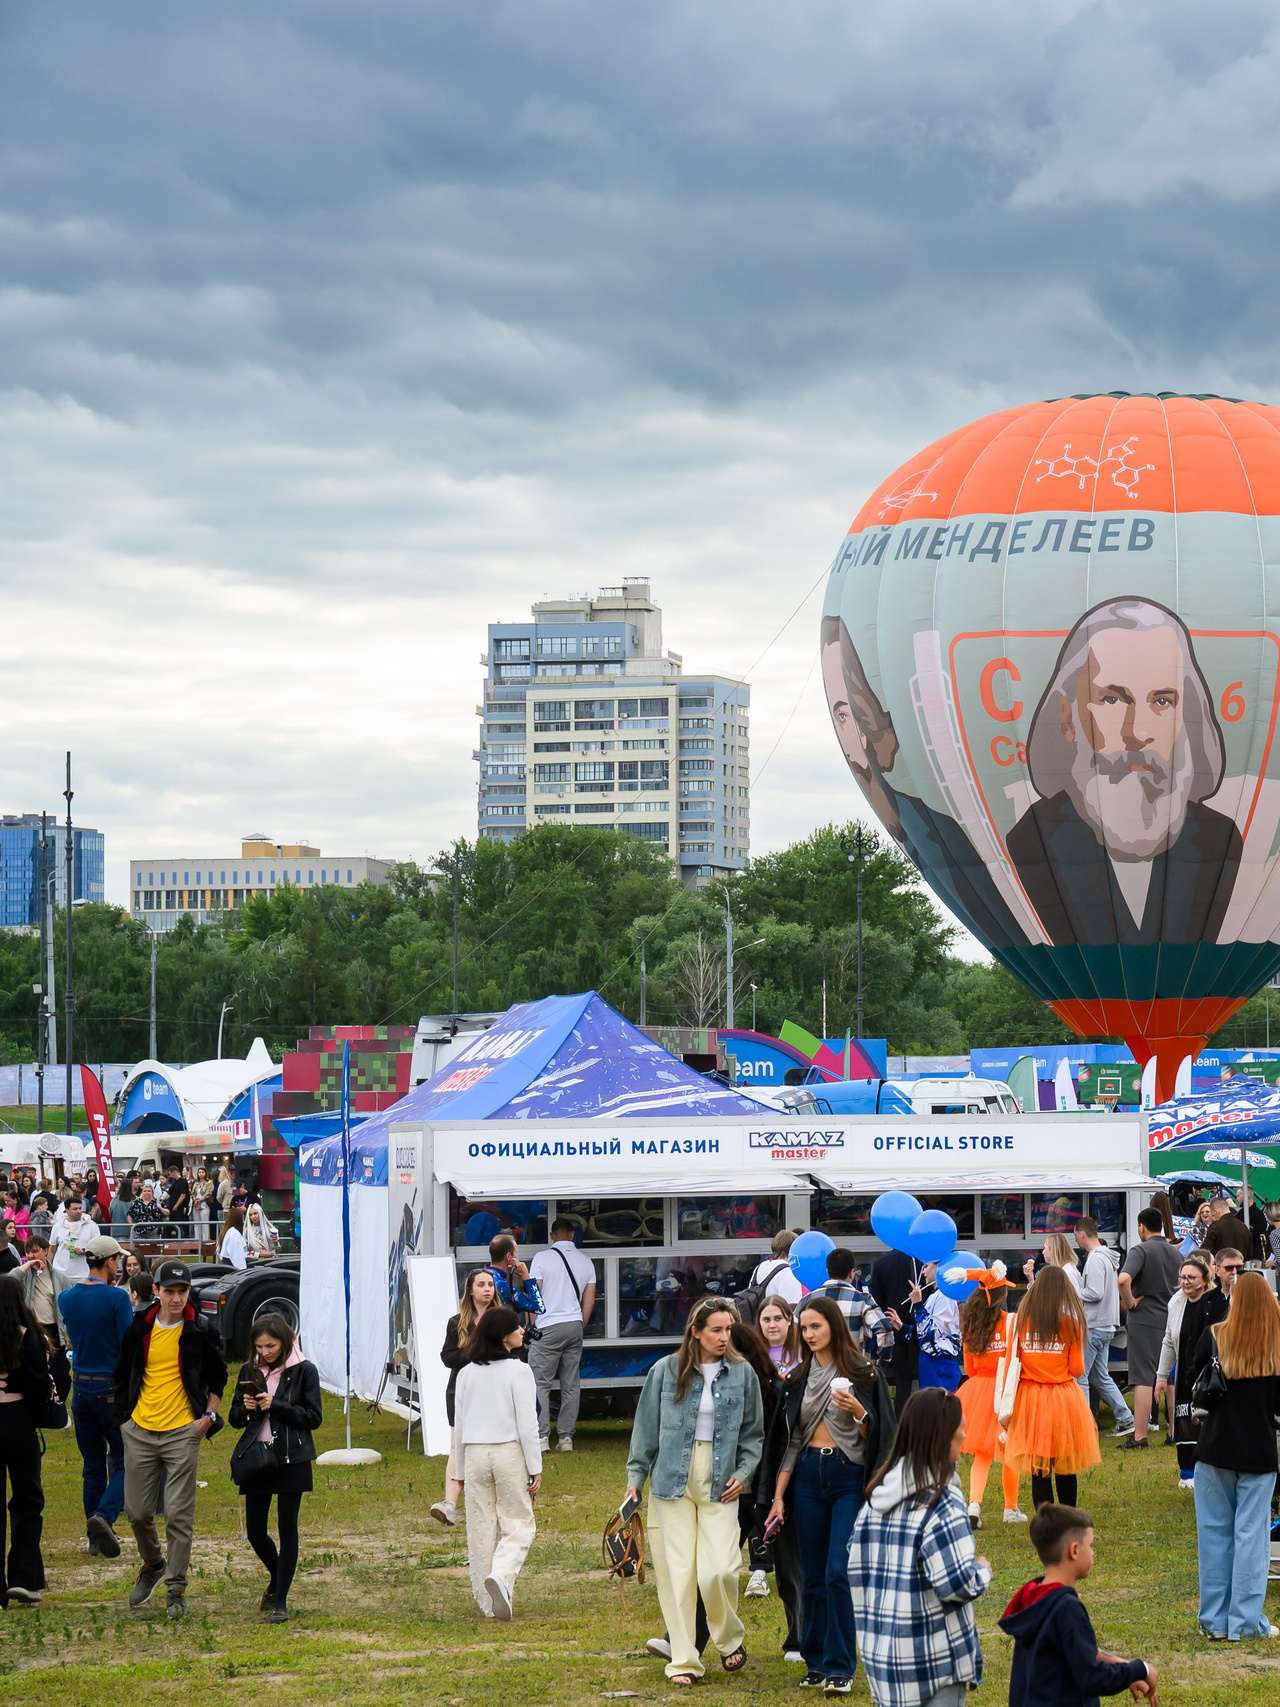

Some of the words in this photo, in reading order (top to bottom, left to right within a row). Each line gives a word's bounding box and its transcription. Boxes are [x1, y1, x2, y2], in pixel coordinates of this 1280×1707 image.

[894, 518, 1156, 563] МЕНДЕЛЕЕВ
[1219, 681, 1246, 723] 6
[153, 1082, 169, 1095] team
[1148, 1110, 1260, 1148] master
[468, 1137, 621, 1159] ОФИЦИАЛЬНЫЙ
[631, 1139, 720, 1155] МАГАЗИН
[749, 1131, 845, 1148] KAMAZ
[873, 1135, 954, 1151] OFFICIAL
[958, 1135, 1015, 1150] STORE
[771, 1147, 827, 1160] master
